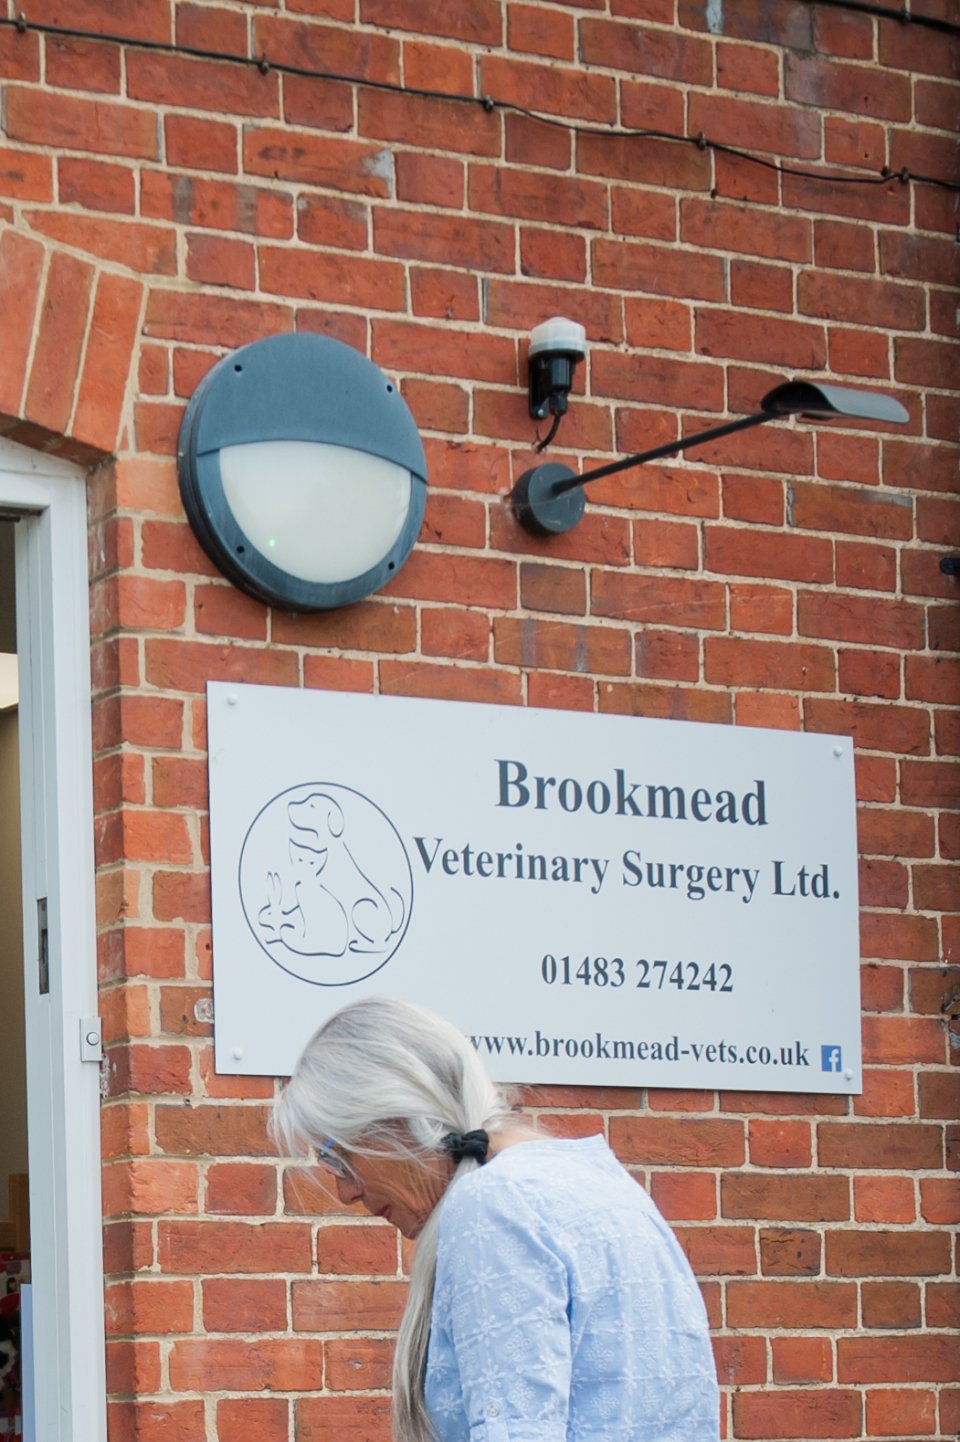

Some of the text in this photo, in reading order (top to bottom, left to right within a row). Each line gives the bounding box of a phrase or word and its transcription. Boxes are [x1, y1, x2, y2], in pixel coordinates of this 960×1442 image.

[494, 758, 769, 827] Brookmead
[413, 836, 840, 904] Veterinary Surgery Ltd.
[540, 954, 734, 994] 01483 274242
